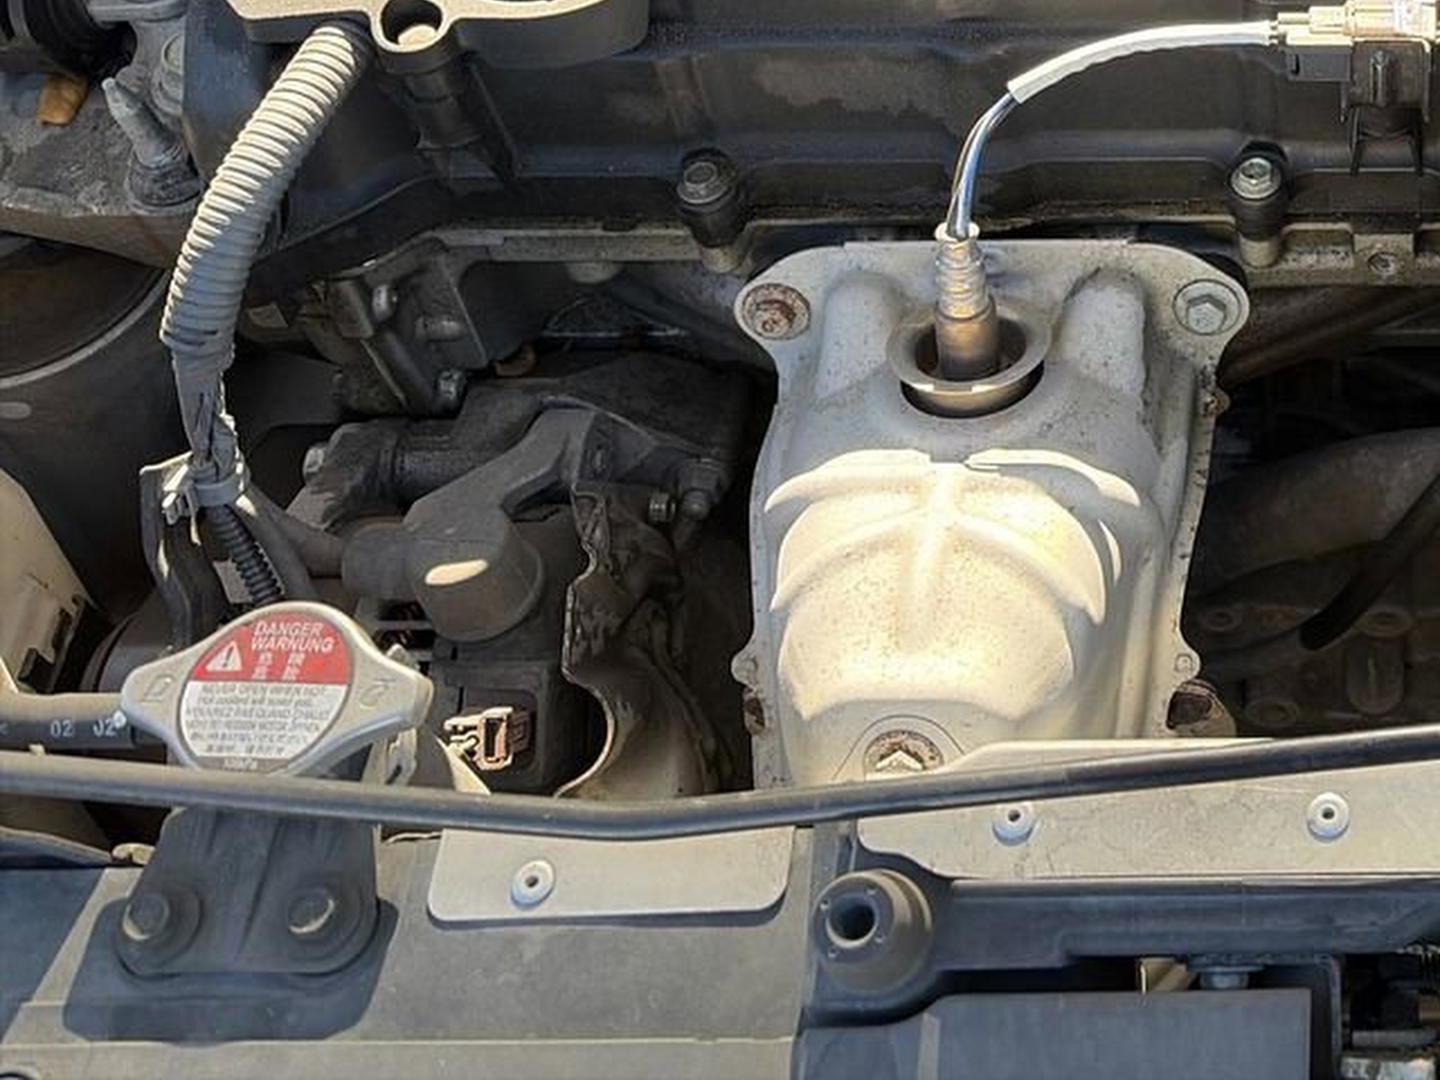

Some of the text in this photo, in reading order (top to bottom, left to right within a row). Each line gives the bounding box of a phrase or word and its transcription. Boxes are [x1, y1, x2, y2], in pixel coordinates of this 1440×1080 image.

[254, 622, 324, 637] DANGER
[251, 635, 335, 653] WARNUNG
[50, 720, 75, 737] 02
